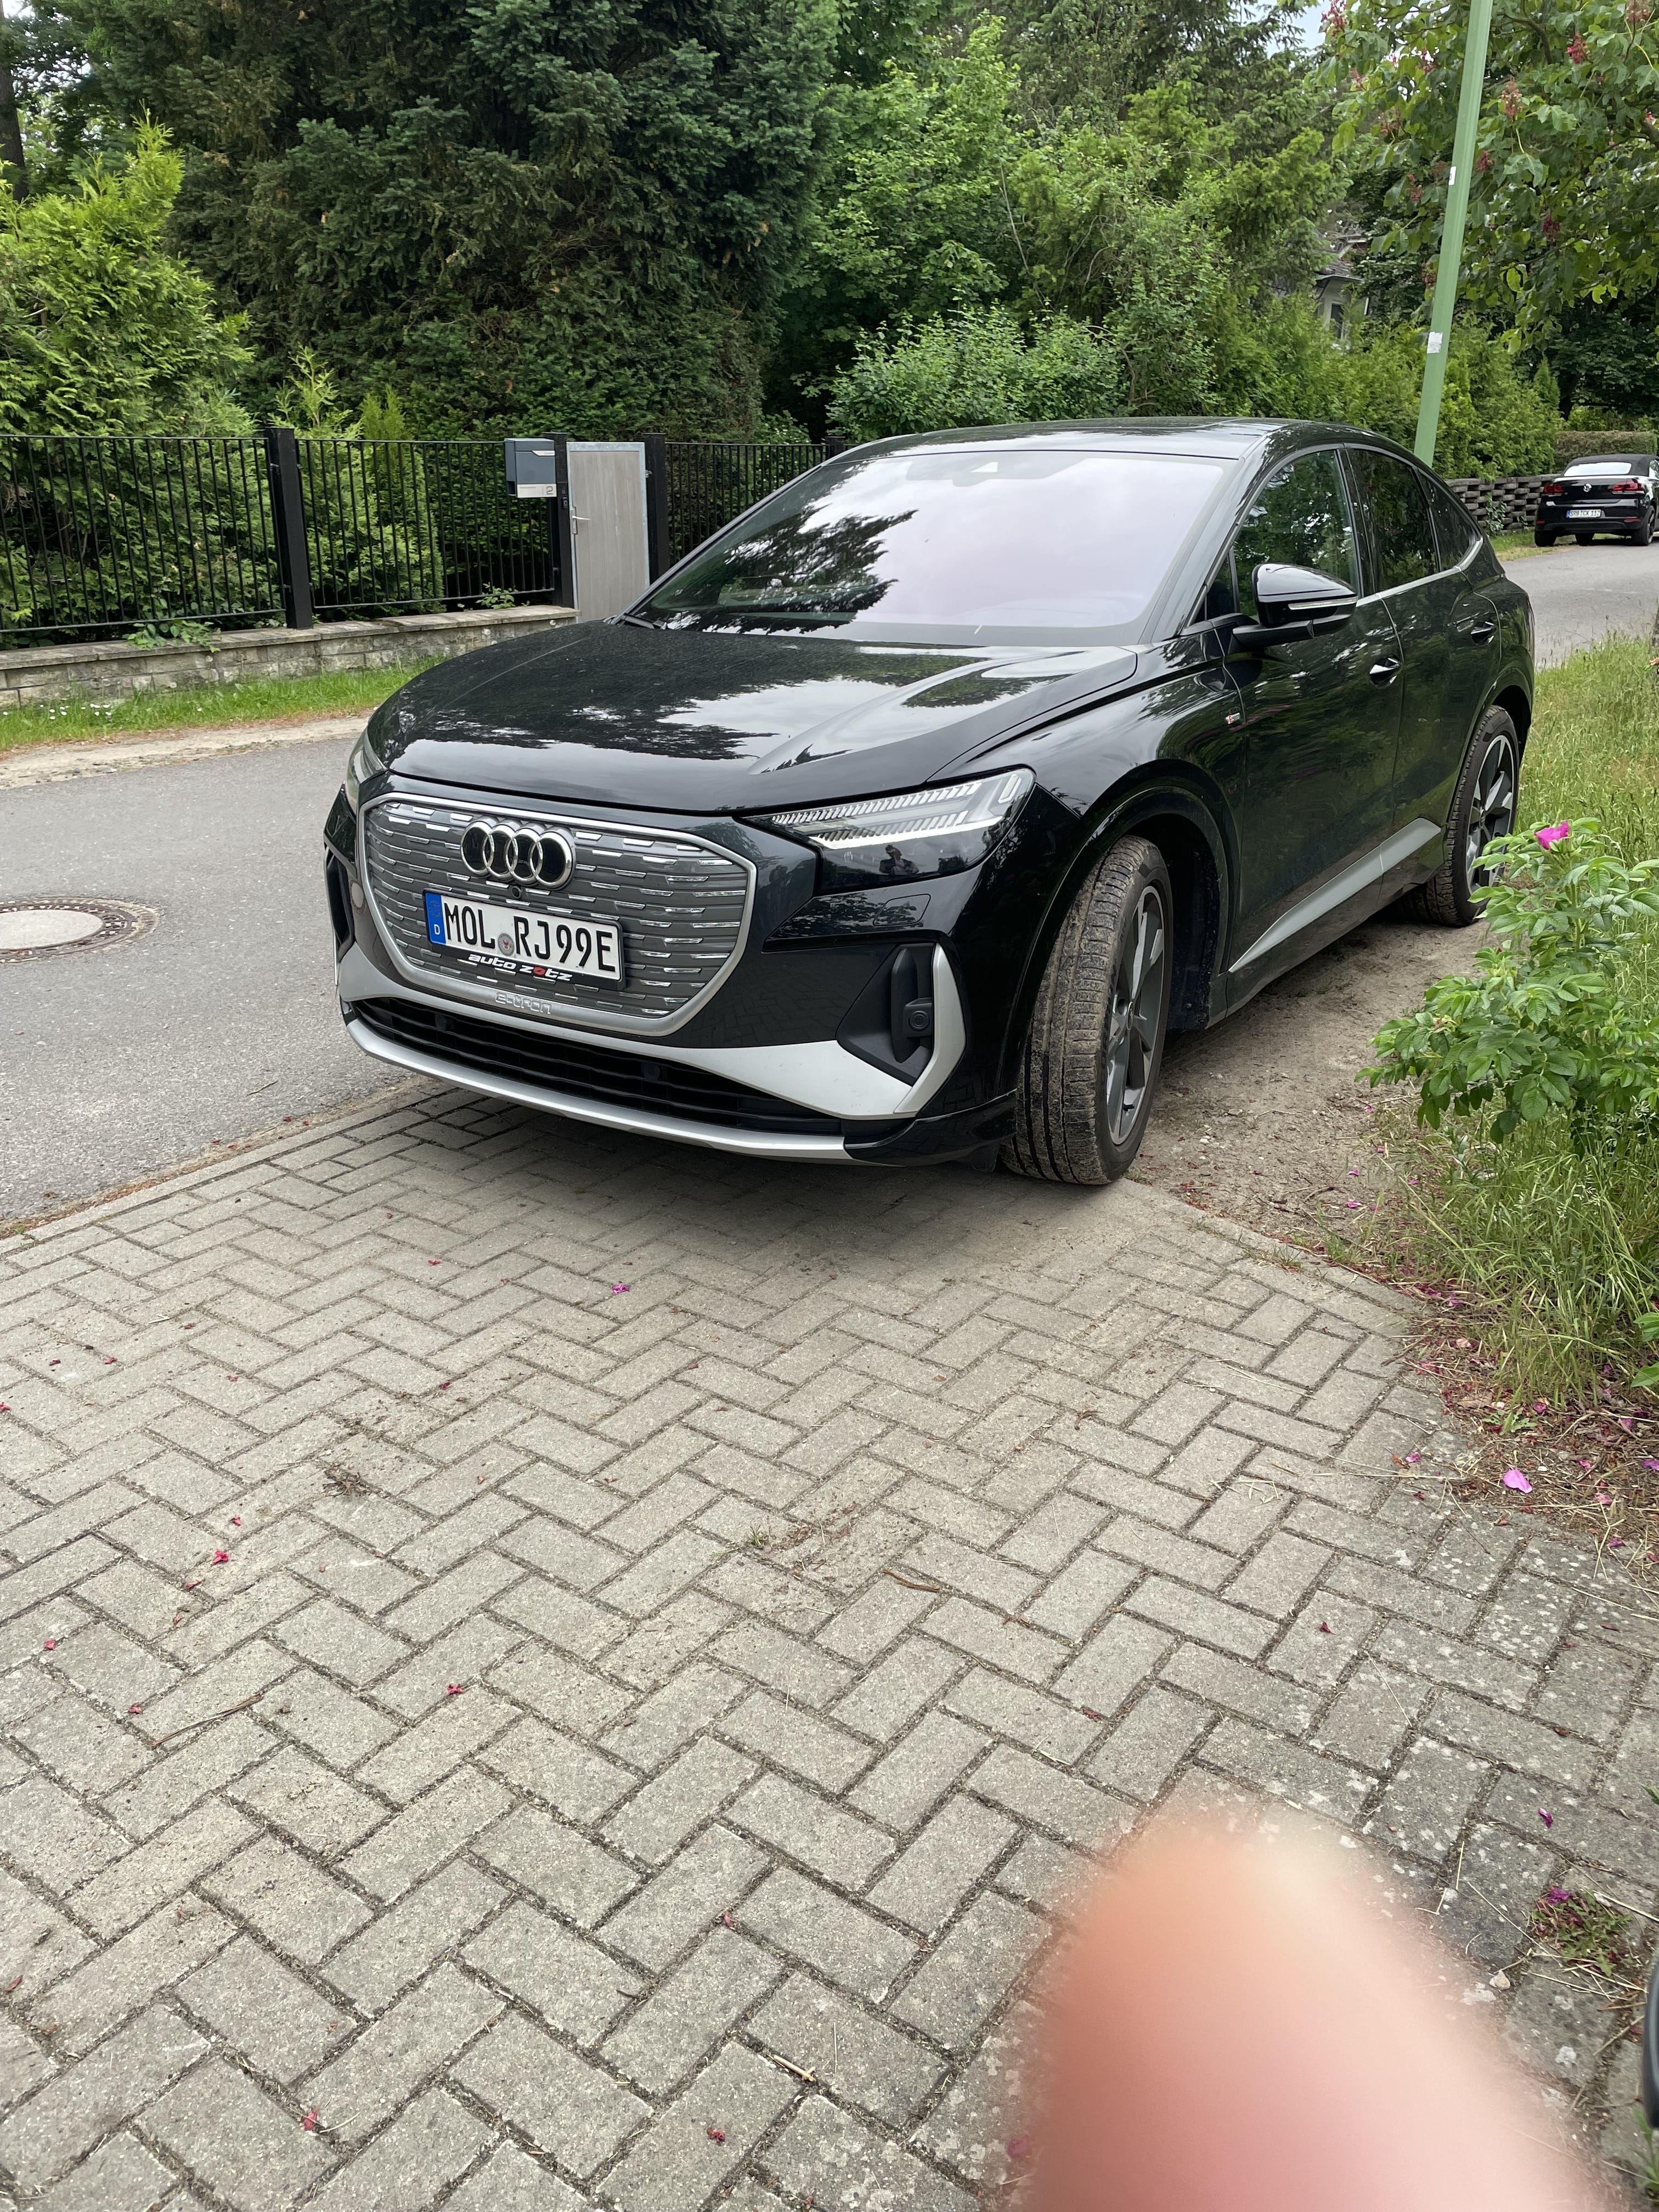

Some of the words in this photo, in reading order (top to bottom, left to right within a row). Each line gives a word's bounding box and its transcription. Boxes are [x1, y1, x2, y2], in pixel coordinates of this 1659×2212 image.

[546, 486, 554, 495] 2
[433, 924, 440, 935] D
[444, 902, 495, 949] MOL
[468, 953, 517, 969] auto
[495, 992, 552, 1014] e-tron
